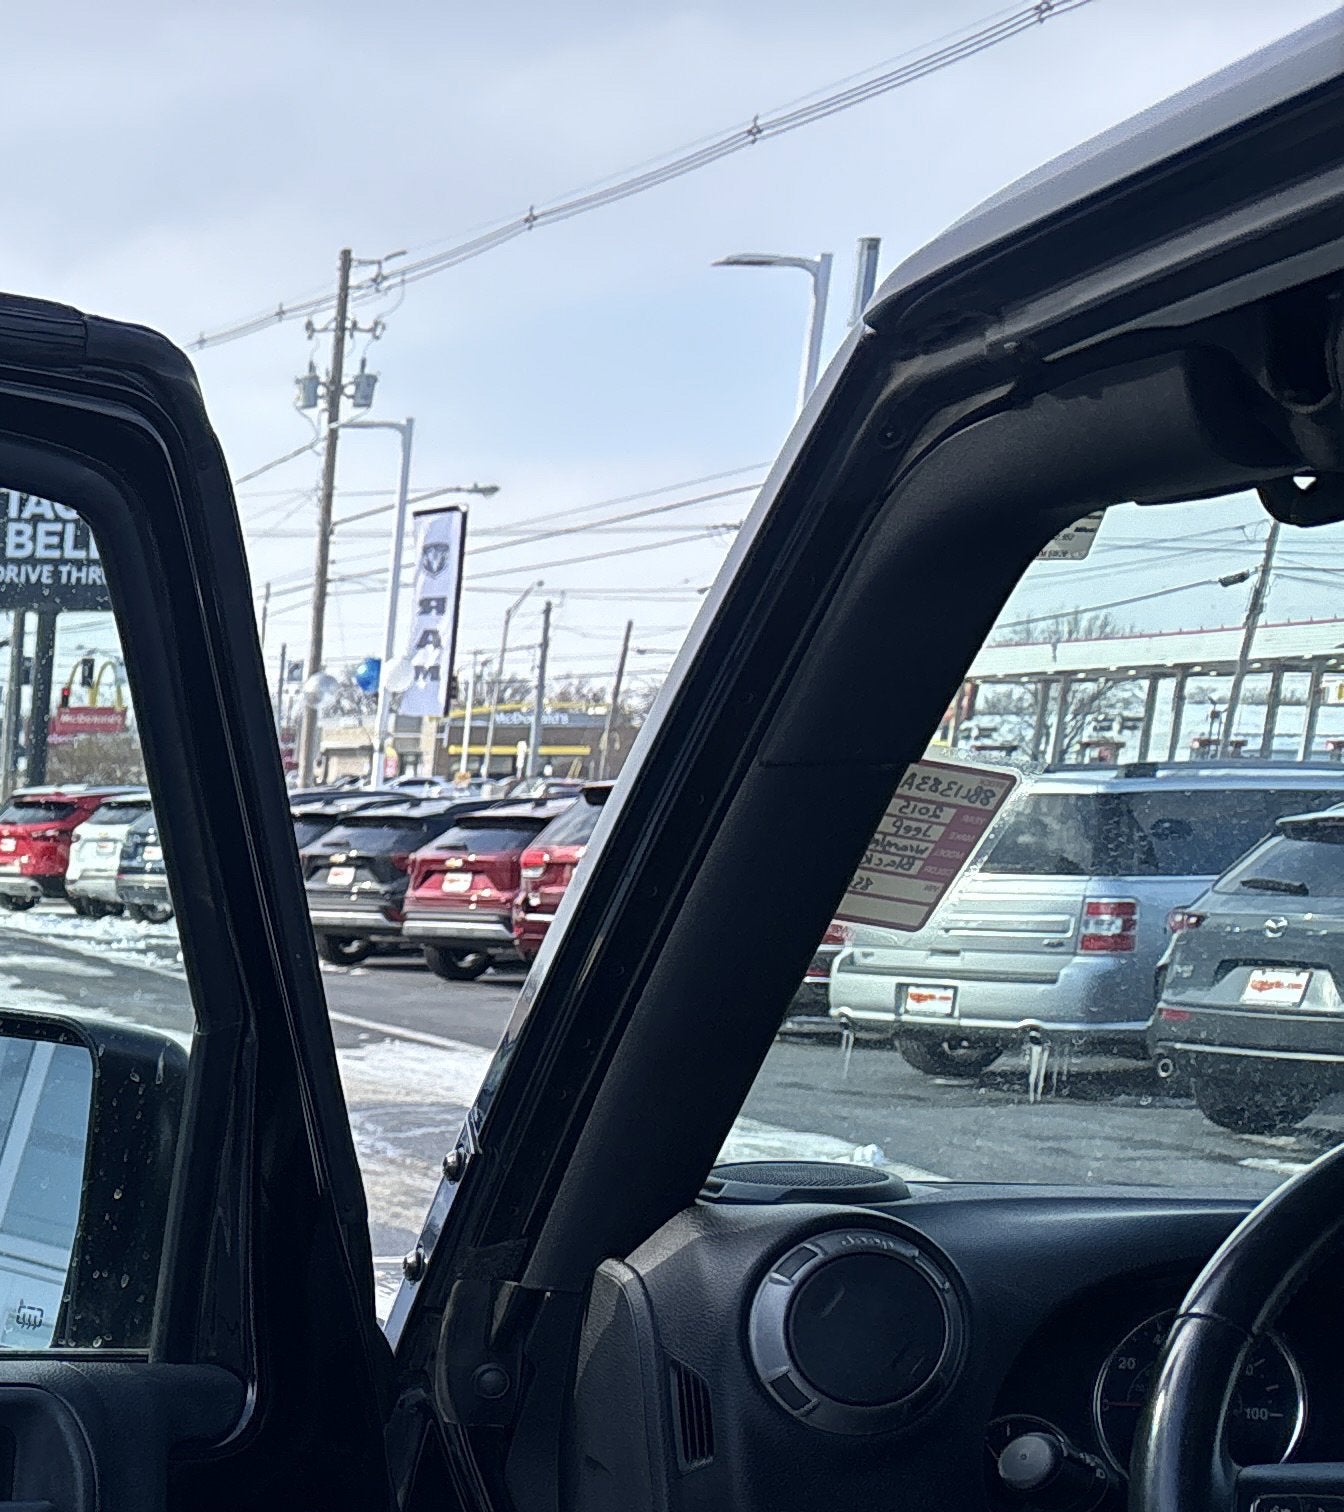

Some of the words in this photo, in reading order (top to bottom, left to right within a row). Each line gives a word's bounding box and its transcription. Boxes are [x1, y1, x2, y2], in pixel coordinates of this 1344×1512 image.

[58, 564, 106, 586] THR
[1117, 1357, 1137, 1370] 20
[1243, 1407, 1269, 1421] 100
